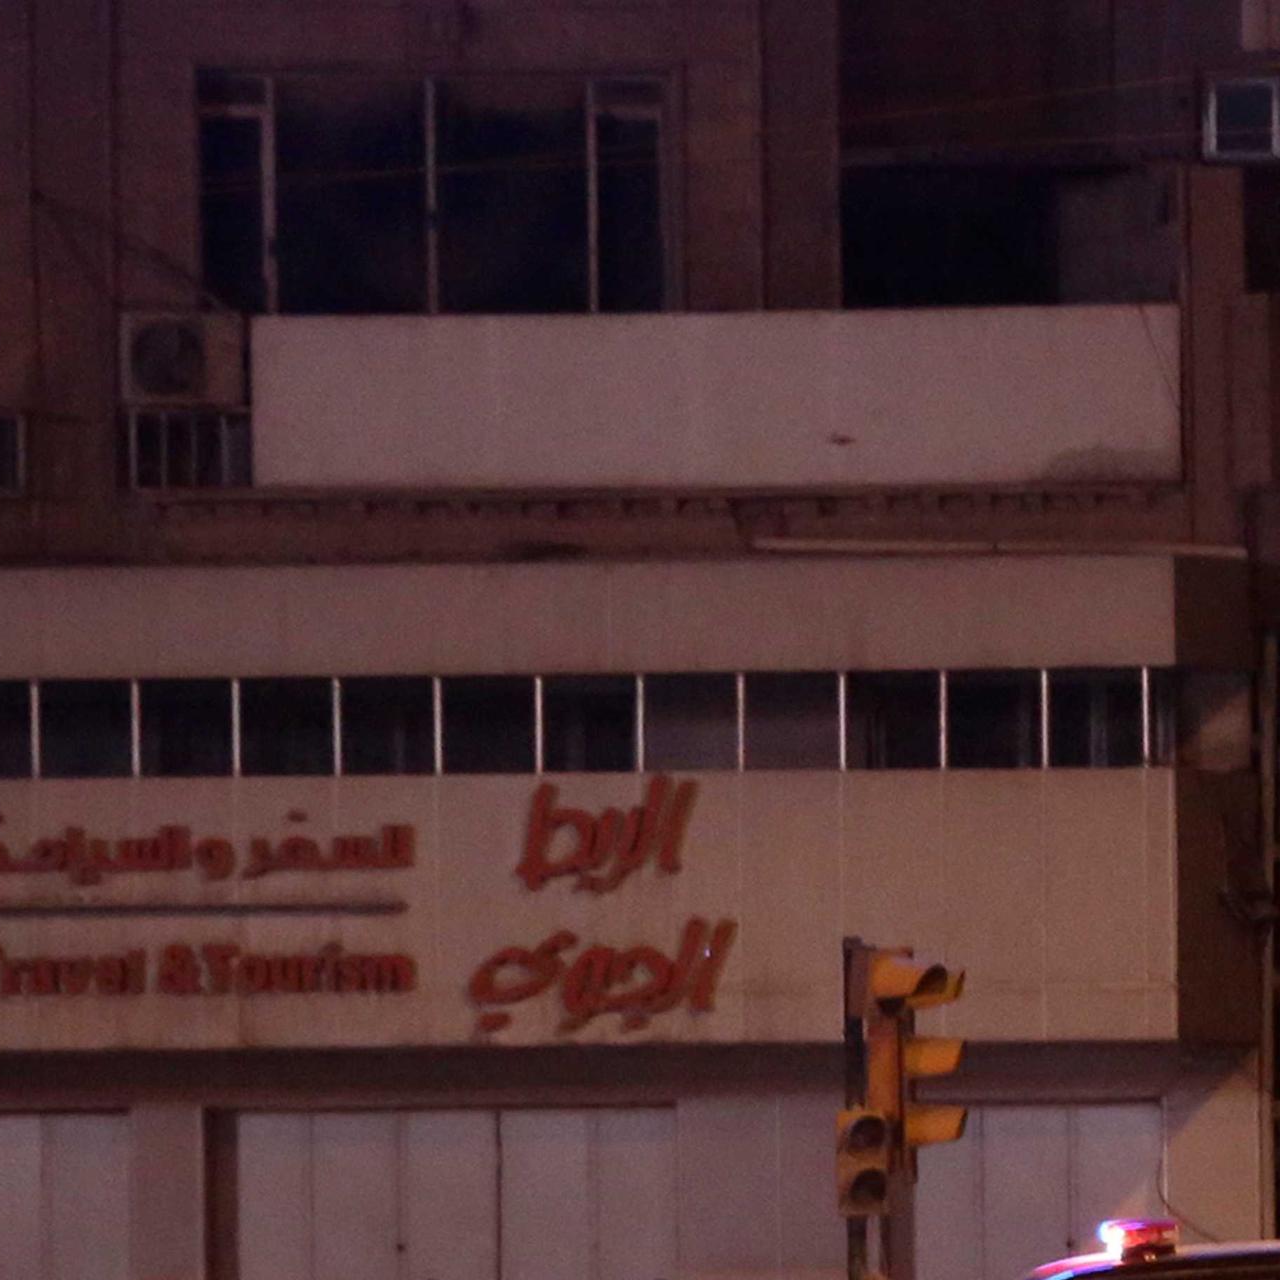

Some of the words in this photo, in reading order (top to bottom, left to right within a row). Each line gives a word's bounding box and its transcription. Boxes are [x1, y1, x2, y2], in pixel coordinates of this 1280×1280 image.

[243, 809, 415, 879] السفر
[515, 774, 699, 893] الربط
[468, 917, 738, 1034] الجوي
